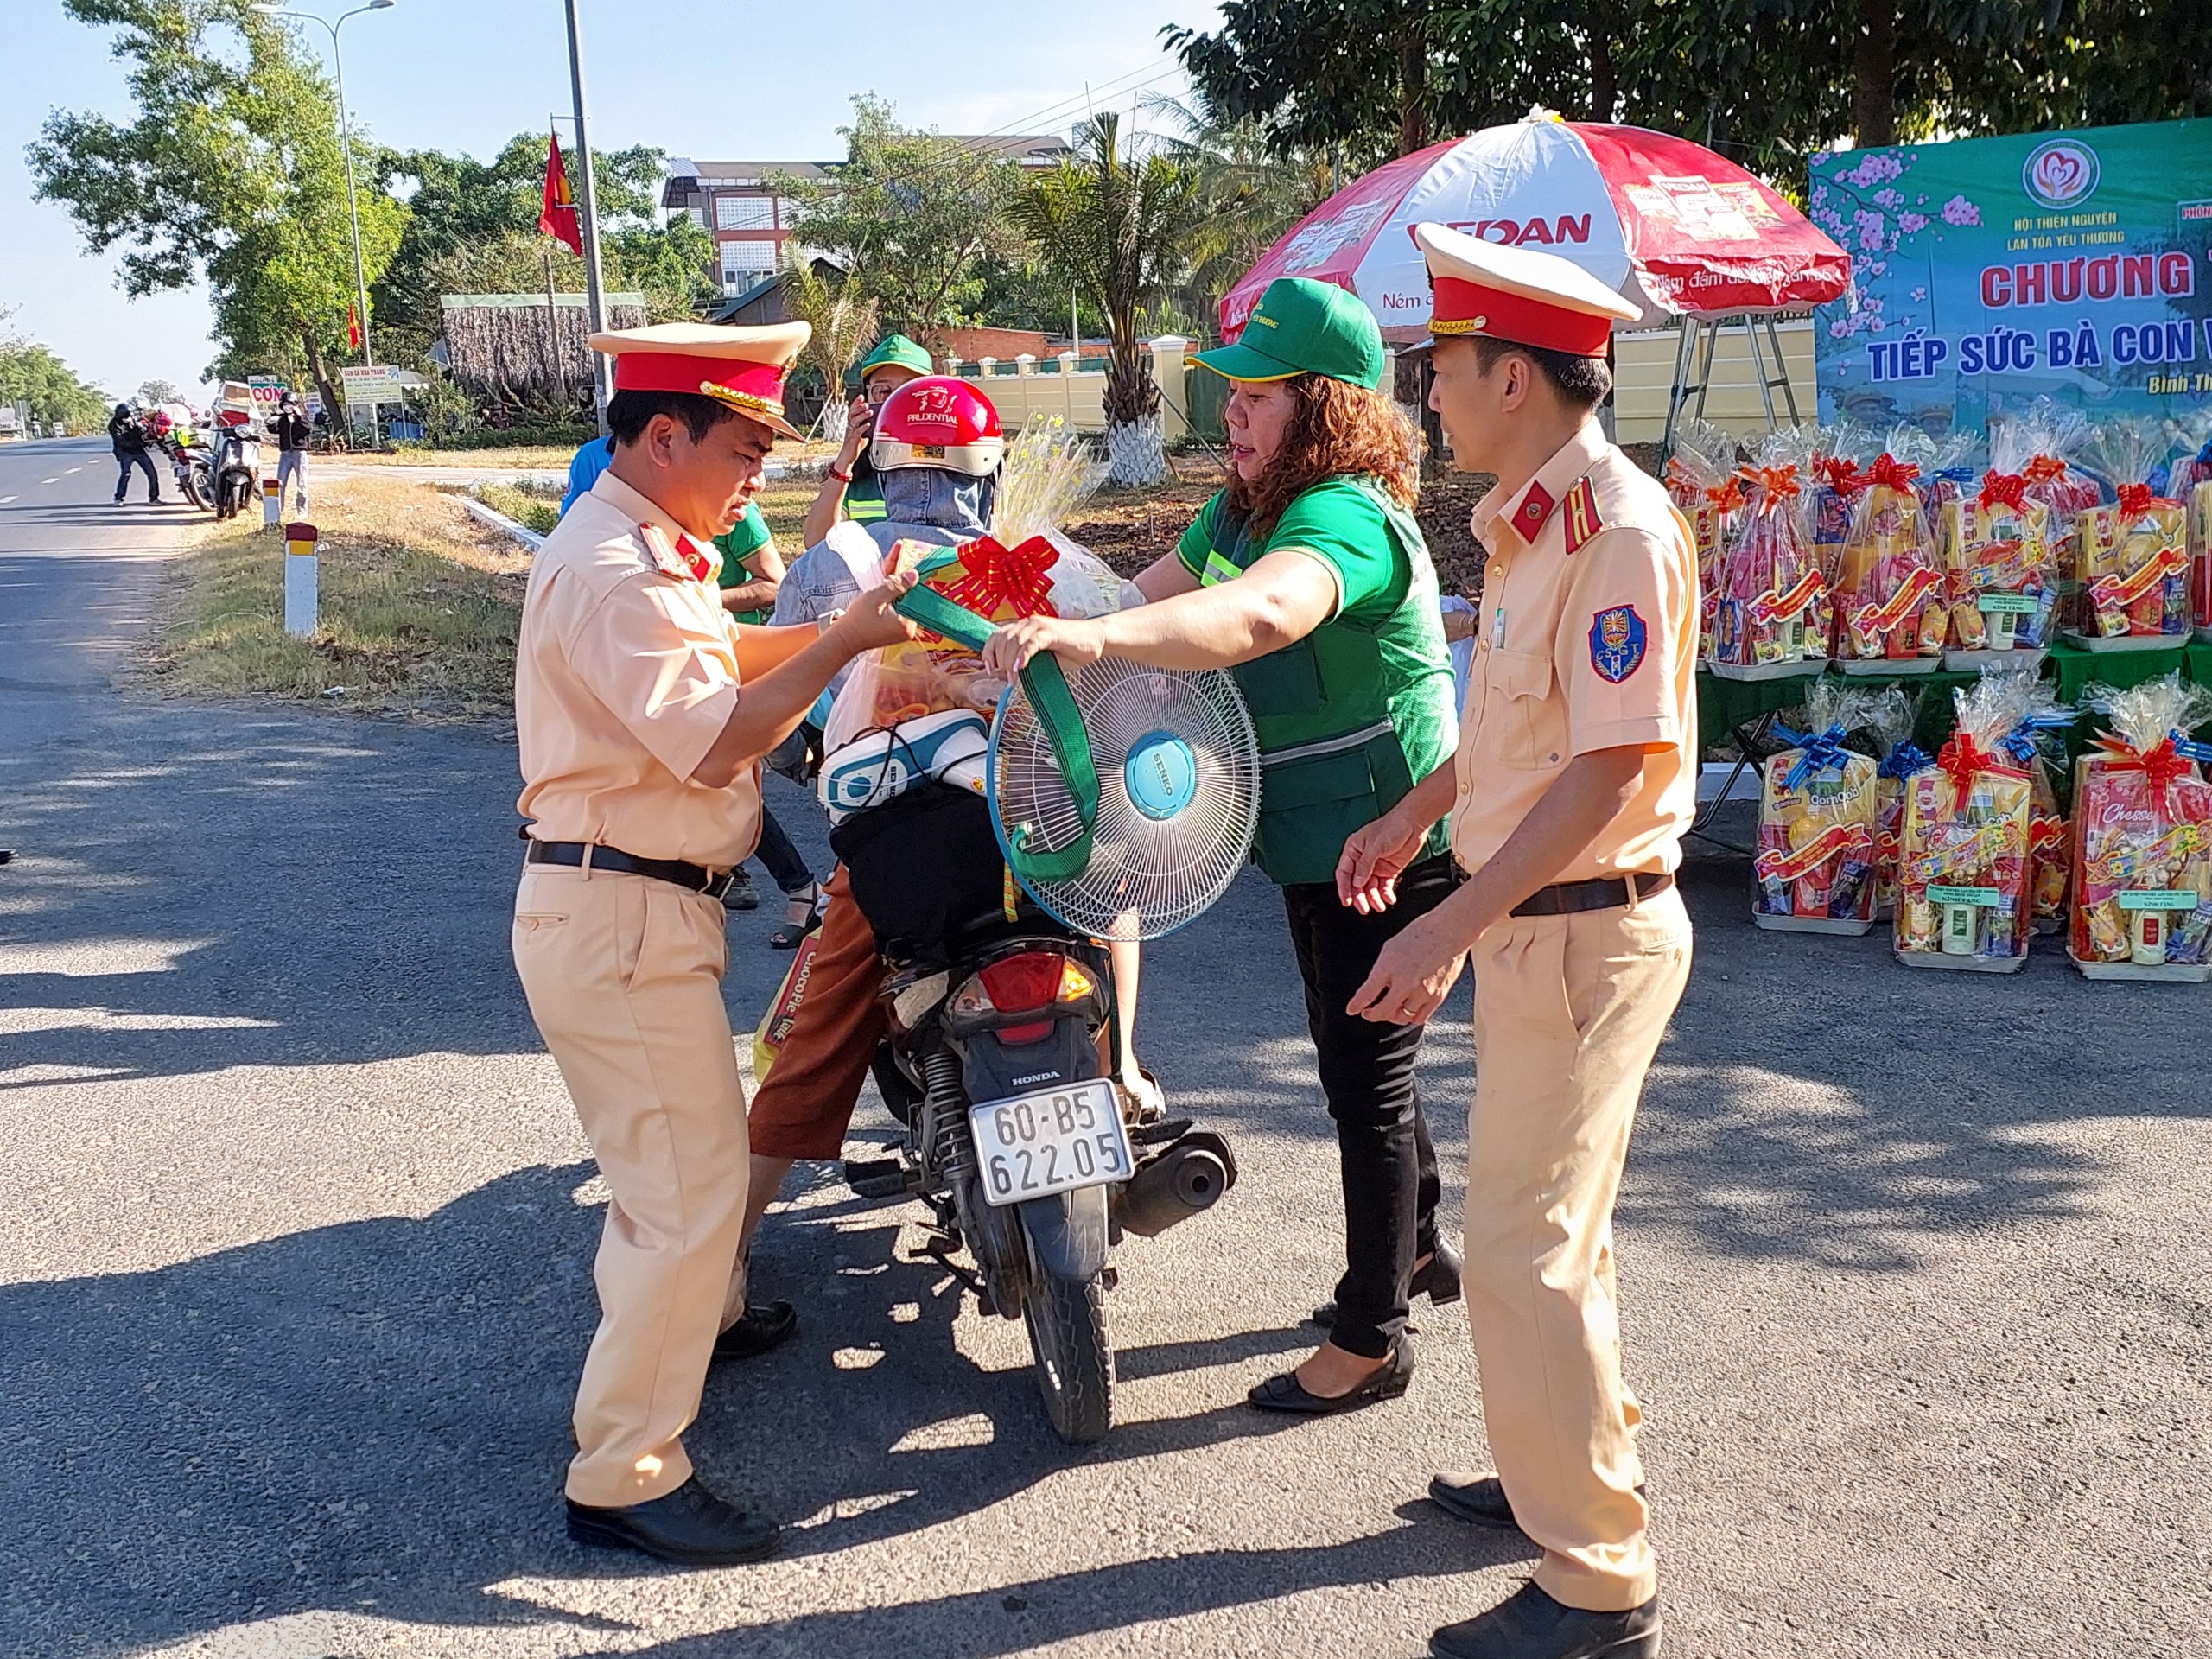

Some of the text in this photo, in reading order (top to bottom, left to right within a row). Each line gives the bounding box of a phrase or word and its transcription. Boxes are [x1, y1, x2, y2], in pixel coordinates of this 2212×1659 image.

[2014, 216, 2032, 232] HỘI
[2007, 238, 2029, 251] LAN
[2056, 232, 2076, 247] YÊU
[2081, 230, 2126, 245] THƯƠNG
[1981, 251, 2193, 308] CHƯƠNG
[1383, 292, 1421, 309] Nêm
[1867, 327, 1948, 381] TIẾP
[1959, 325, 2036, 375] SỨC
[2049, 318, 2102, 368] BÀ
[2113, 321, 2195, 365] CON
[907, 413, 958, 425] PRUDENTIAL
[1596, 643, 1639, 660] CSGT
[1154, 753, 1173, 797] SENKO
[1012, 1071, 1061, 1086] HONDA
[995, 1091, 1096, 1146] 60-B5
[990, 1133, 1121, 1194] 622.05
